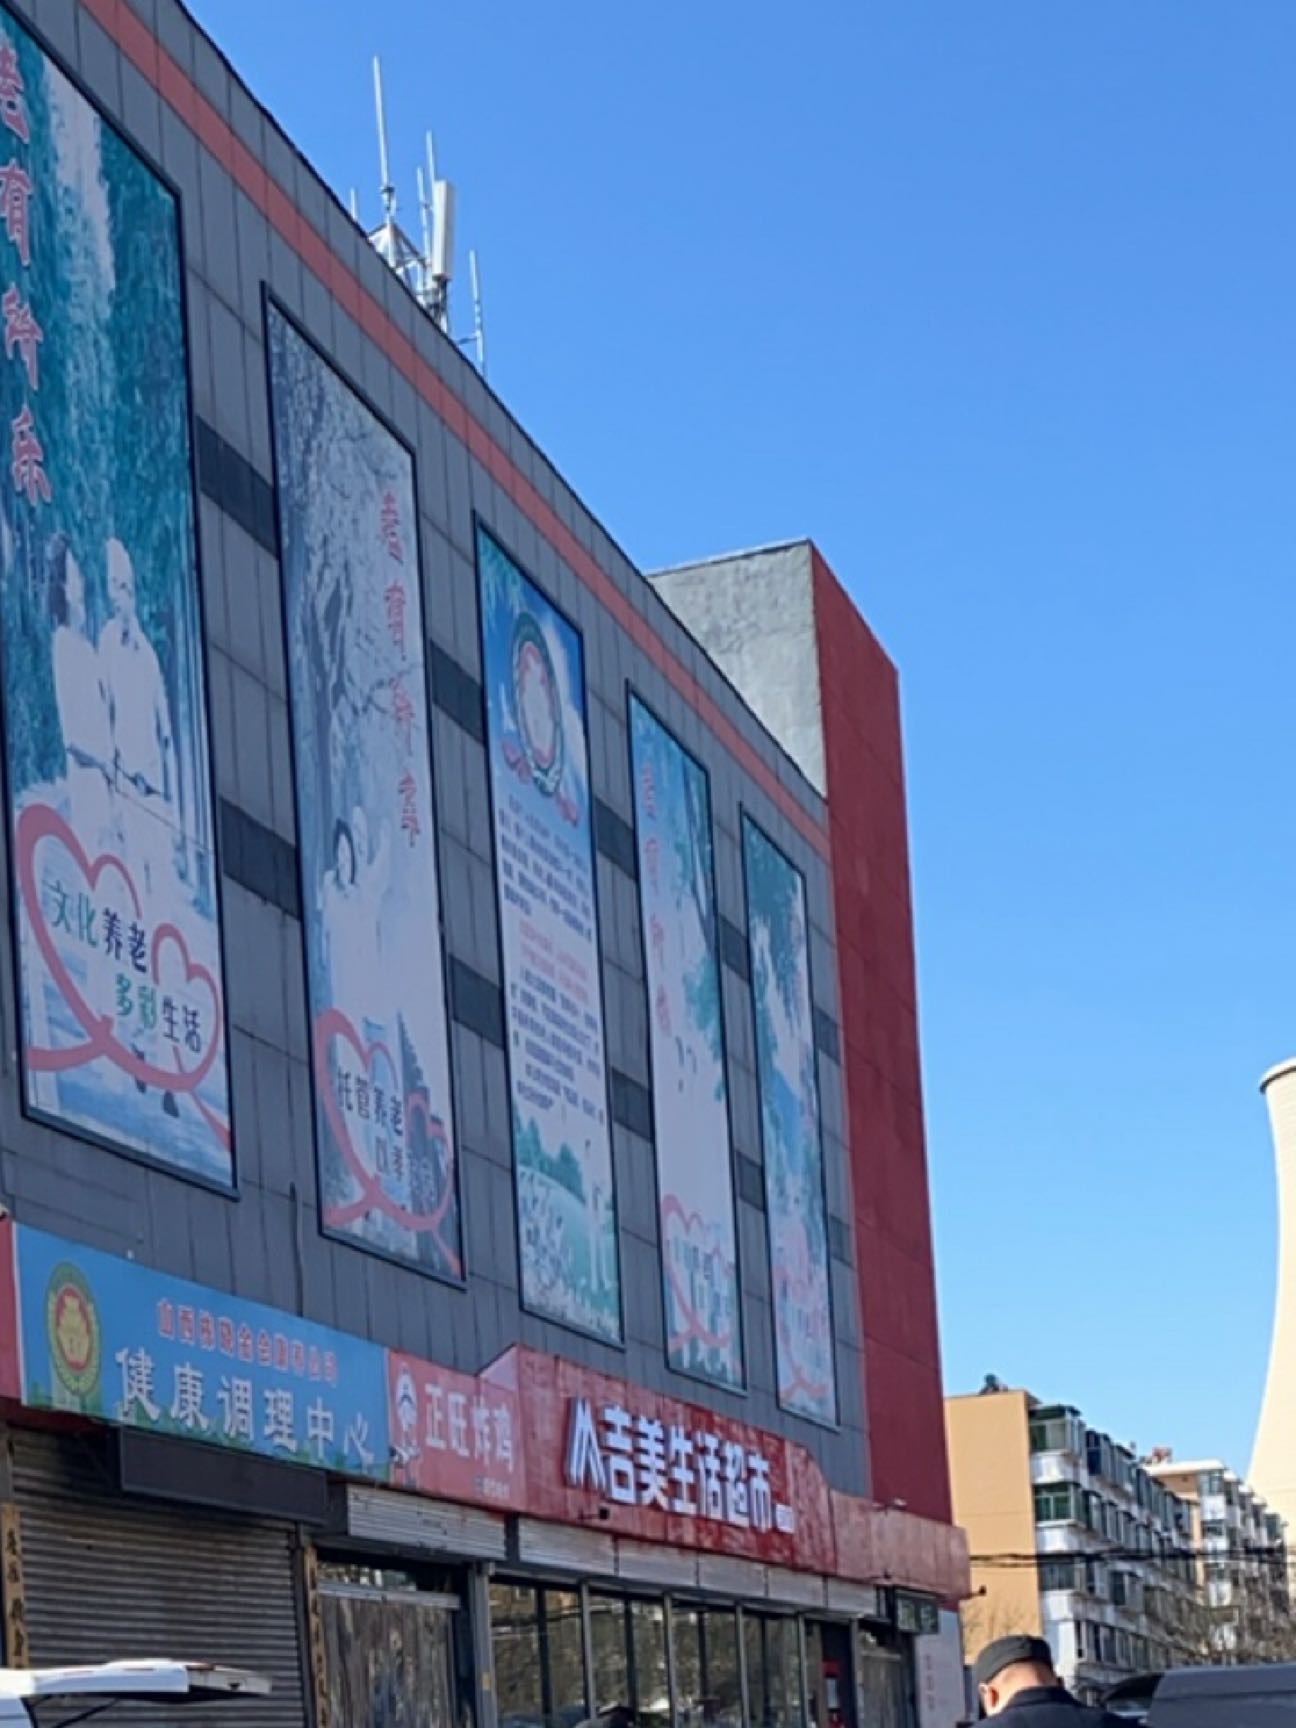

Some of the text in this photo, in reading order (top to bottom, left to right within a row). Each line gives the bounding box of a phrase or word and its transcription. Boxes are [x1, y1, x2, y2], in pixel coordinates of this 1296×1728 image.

[43, 879, 147, 973] 文化养老
[115, 1347, 375, 1475] 健康调理中心
[601, 1403, 772, 1533] 吉美生活超市
